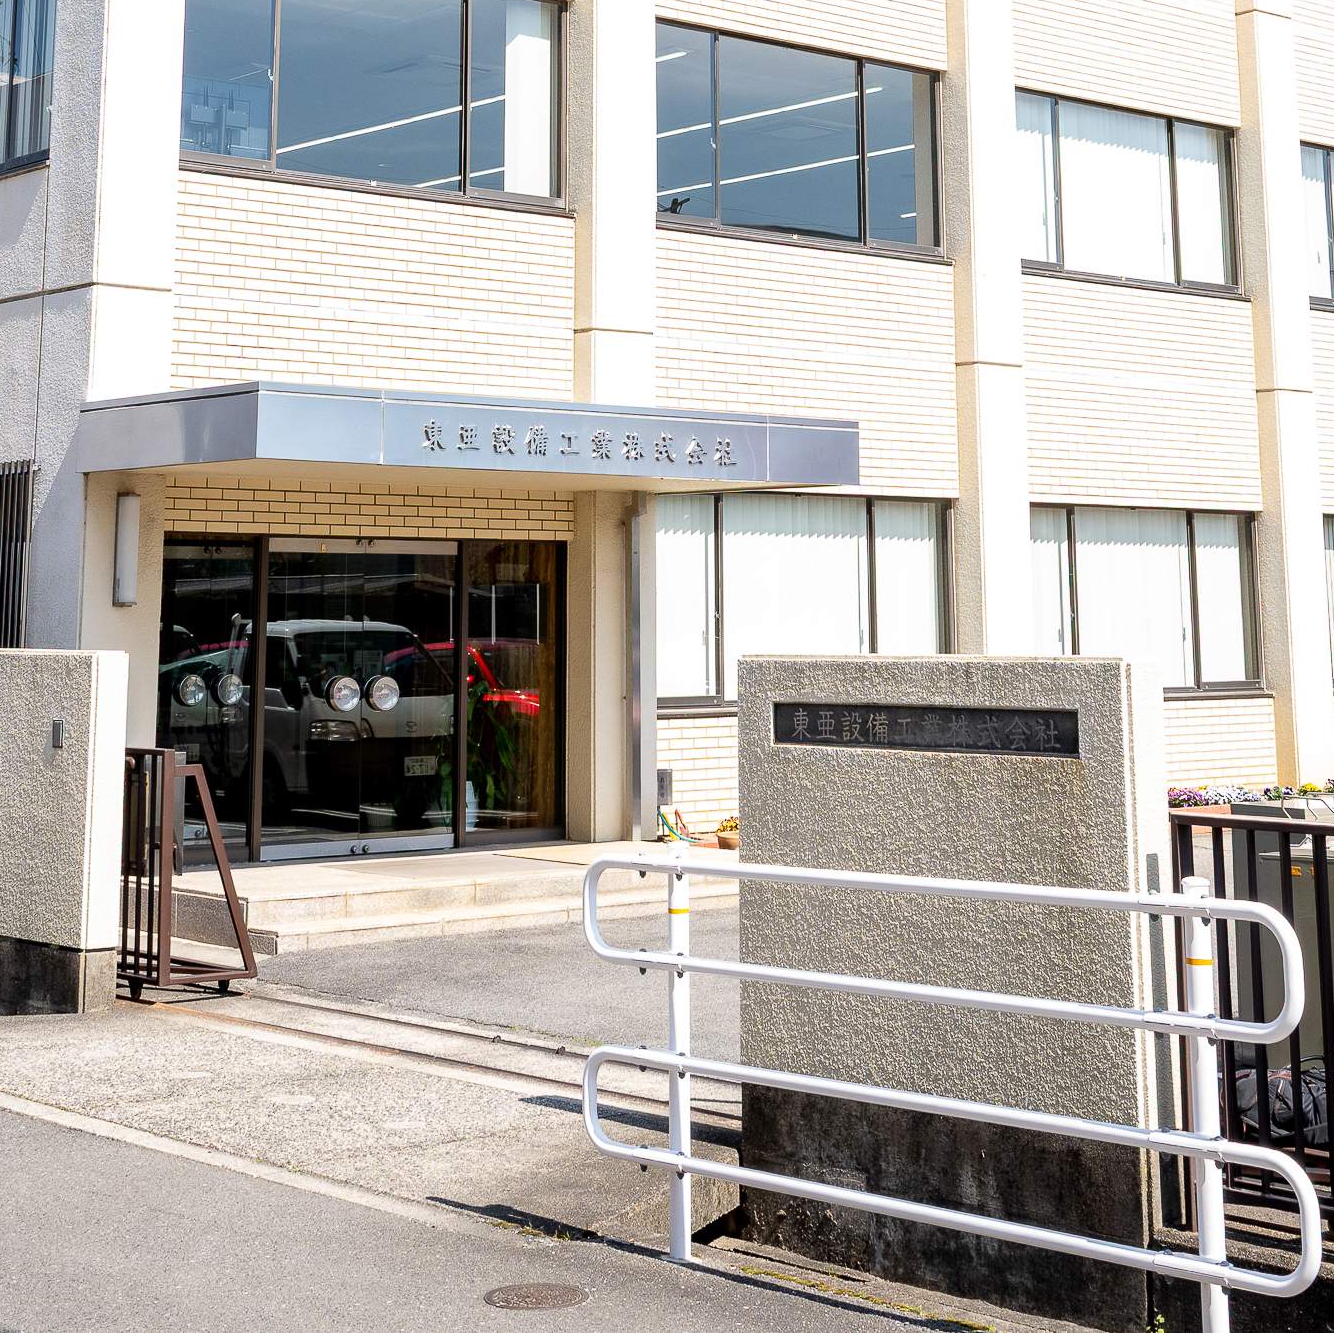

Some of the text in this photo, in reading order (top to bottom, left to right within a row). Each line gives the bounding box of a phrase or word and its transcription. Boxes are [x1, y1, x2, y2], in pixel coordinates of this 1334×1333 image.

[420, 418, 738, 466] 東亜設備工業株式会社
[791, 707, 1062, 750] 東亜設備工業株式会社
